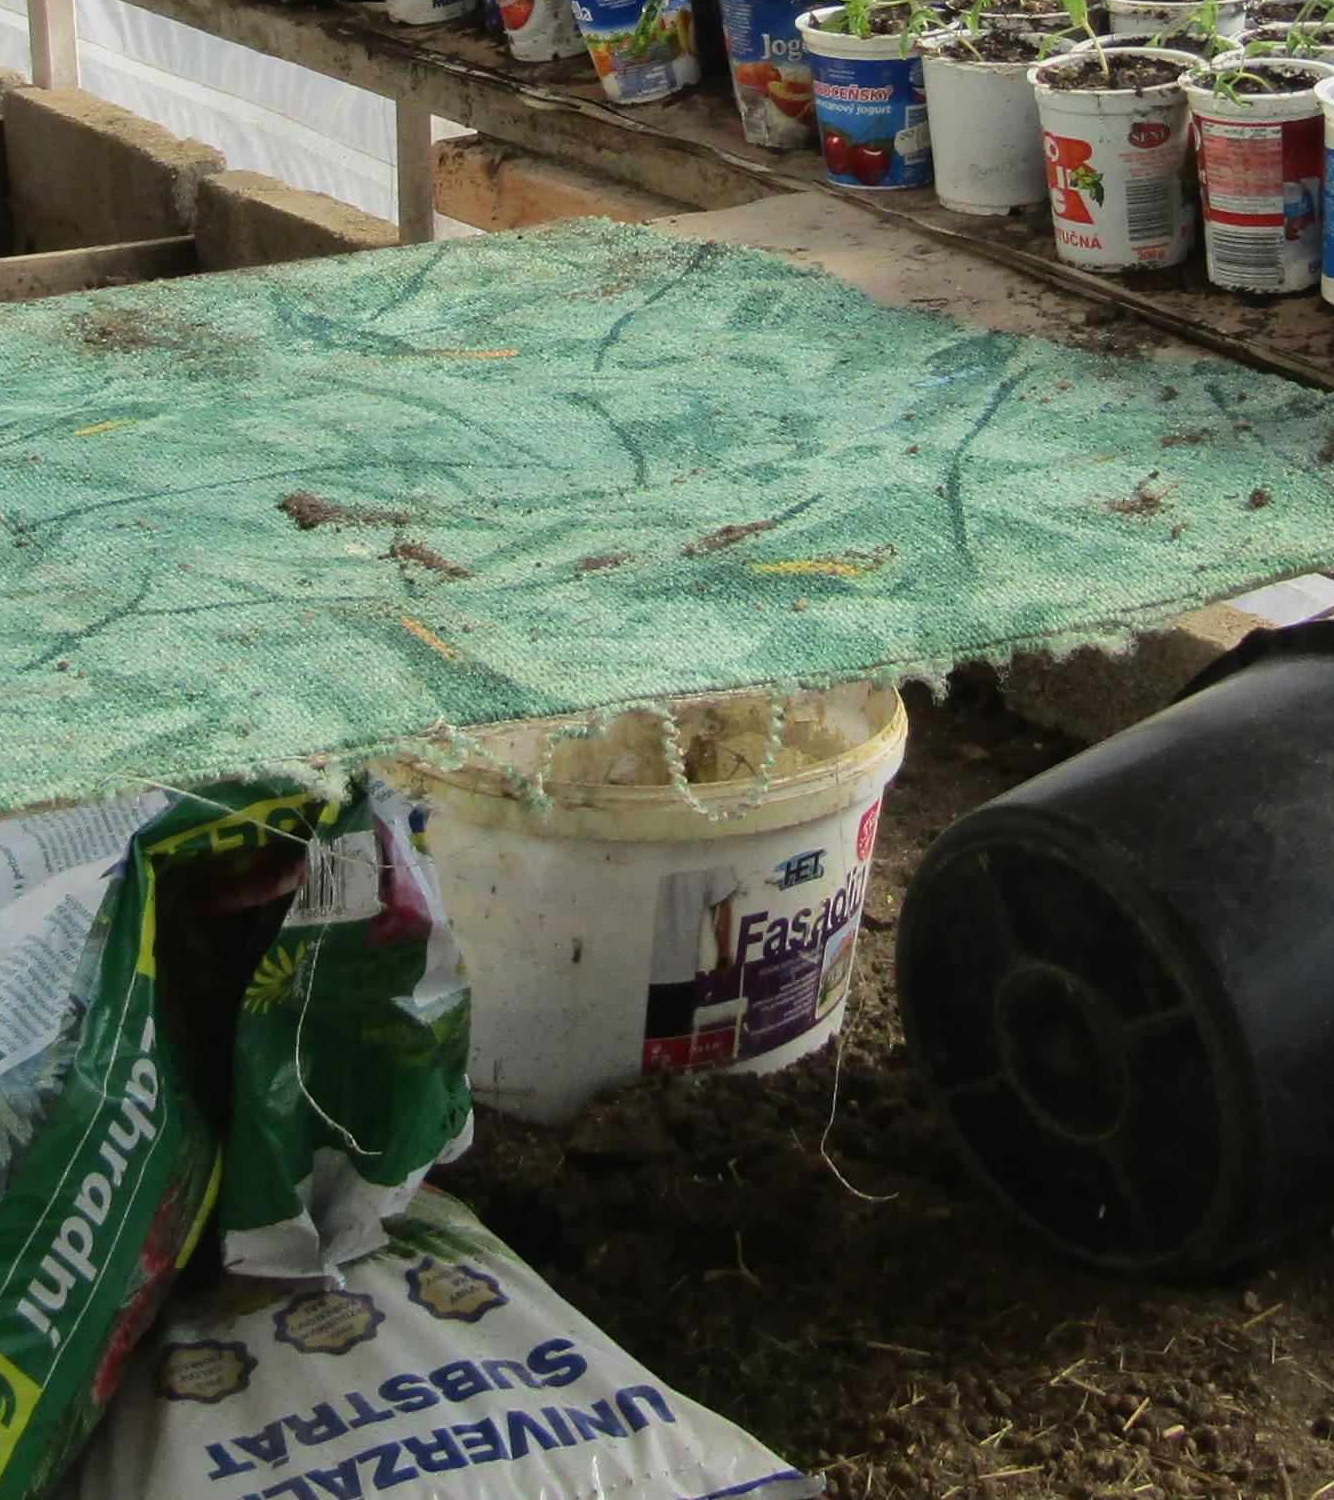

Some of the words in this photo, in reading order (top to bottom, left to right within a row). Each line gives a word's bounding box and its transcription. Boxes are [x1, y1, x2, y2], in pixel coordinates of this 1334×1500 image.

[856, 104, 892, 117] jogurt
[1055, 226, 1103, 250] TUČNÁ
[781, 848, 828, 888] HET
[205, 1336, 589, 1481] SUBSTRÁT
